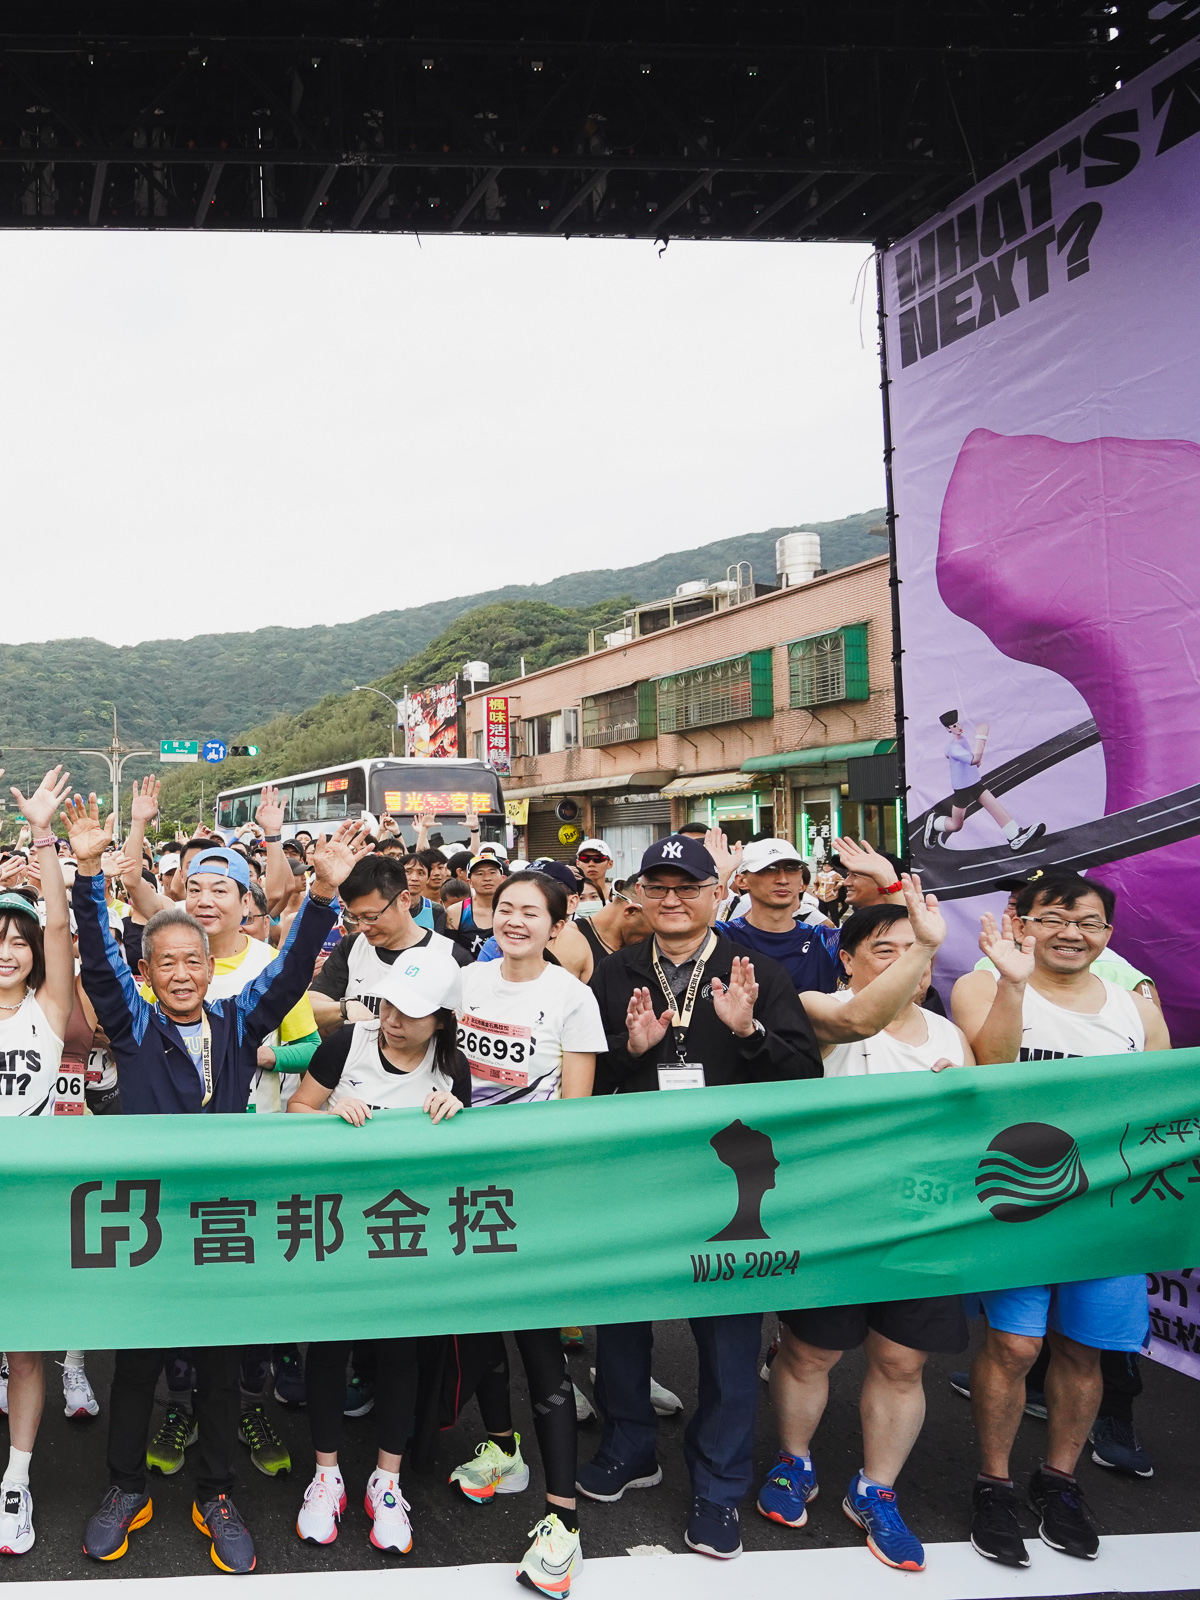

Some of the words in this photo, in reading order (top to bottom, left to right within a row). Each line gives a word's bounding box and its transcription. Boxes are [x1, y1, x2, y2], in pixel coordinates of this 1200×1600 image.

[895, 108, 1141, 307] WHAT'S
[899, 202, 1103, 369] NEXT?
[563, 830, 577, 840] Bar
[456, 1028, 525, 1063] 26693
[1130, 1155, 1200, 1205] 太
[190, 1184, 518, 1266] 富邦金控
[690, 1252, 736, 1283] WJS
[742, 1250, 800, 1279] 2024
